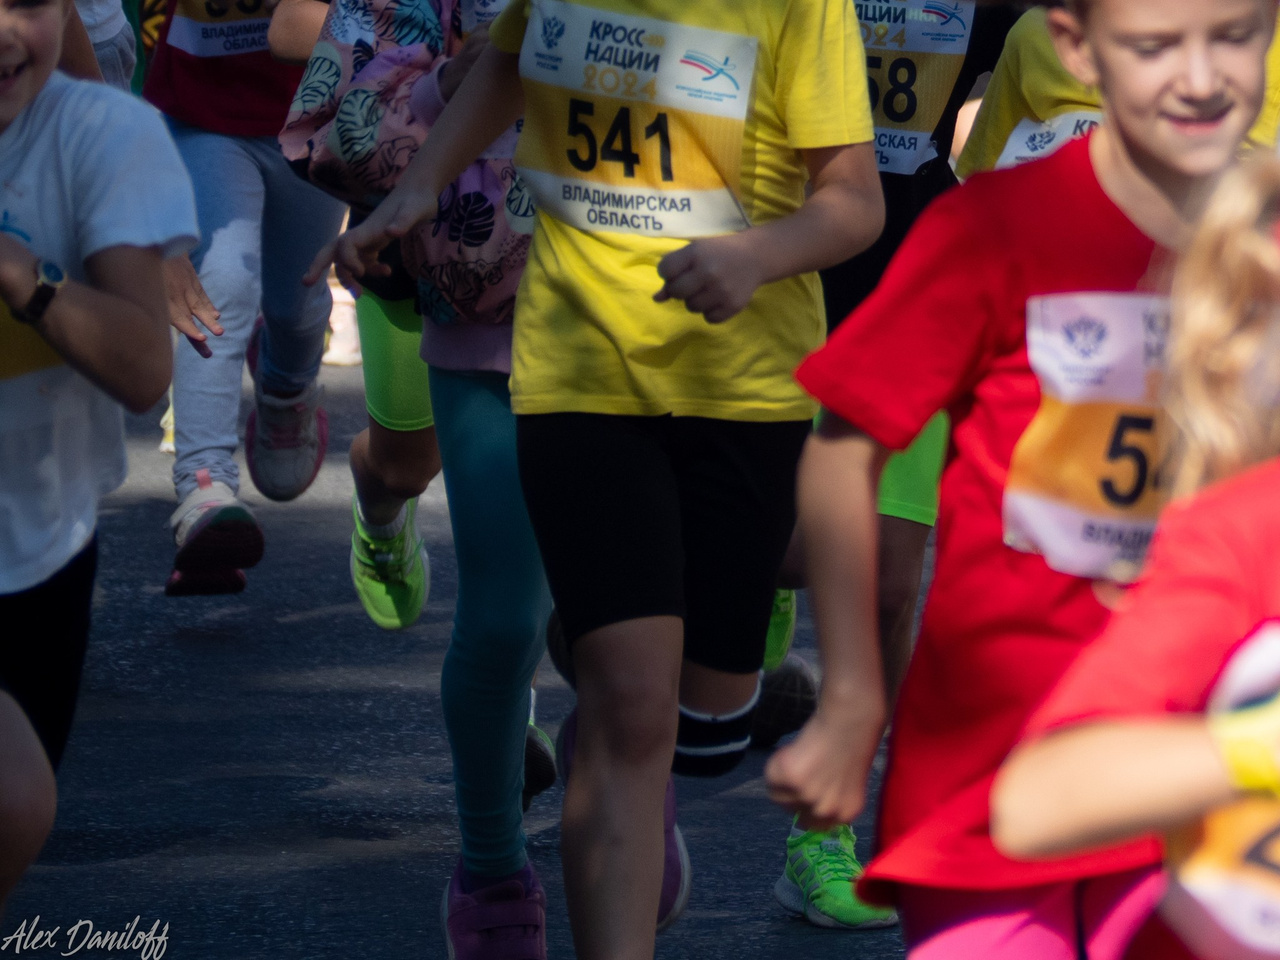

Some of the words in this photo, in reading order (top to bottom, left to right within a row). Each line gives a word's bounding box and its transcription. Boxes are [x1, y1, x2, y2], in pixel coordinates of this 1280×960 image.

[201, 21, 269, 40] ВЛАДИМИР
[223, 35, 267, 51] ОБЛАС
[589, 19, 645, 48] КРОСС
[584, 41, 661, 73] НАЦИИ
[581, 63, 658, 102] 2024
[566, 98, 674, 182] 541
[561, 184, 692, 212] ВЛАДИМИРСКАЯ
[586, 209, 663, 231] ОБЛАСТЬ
